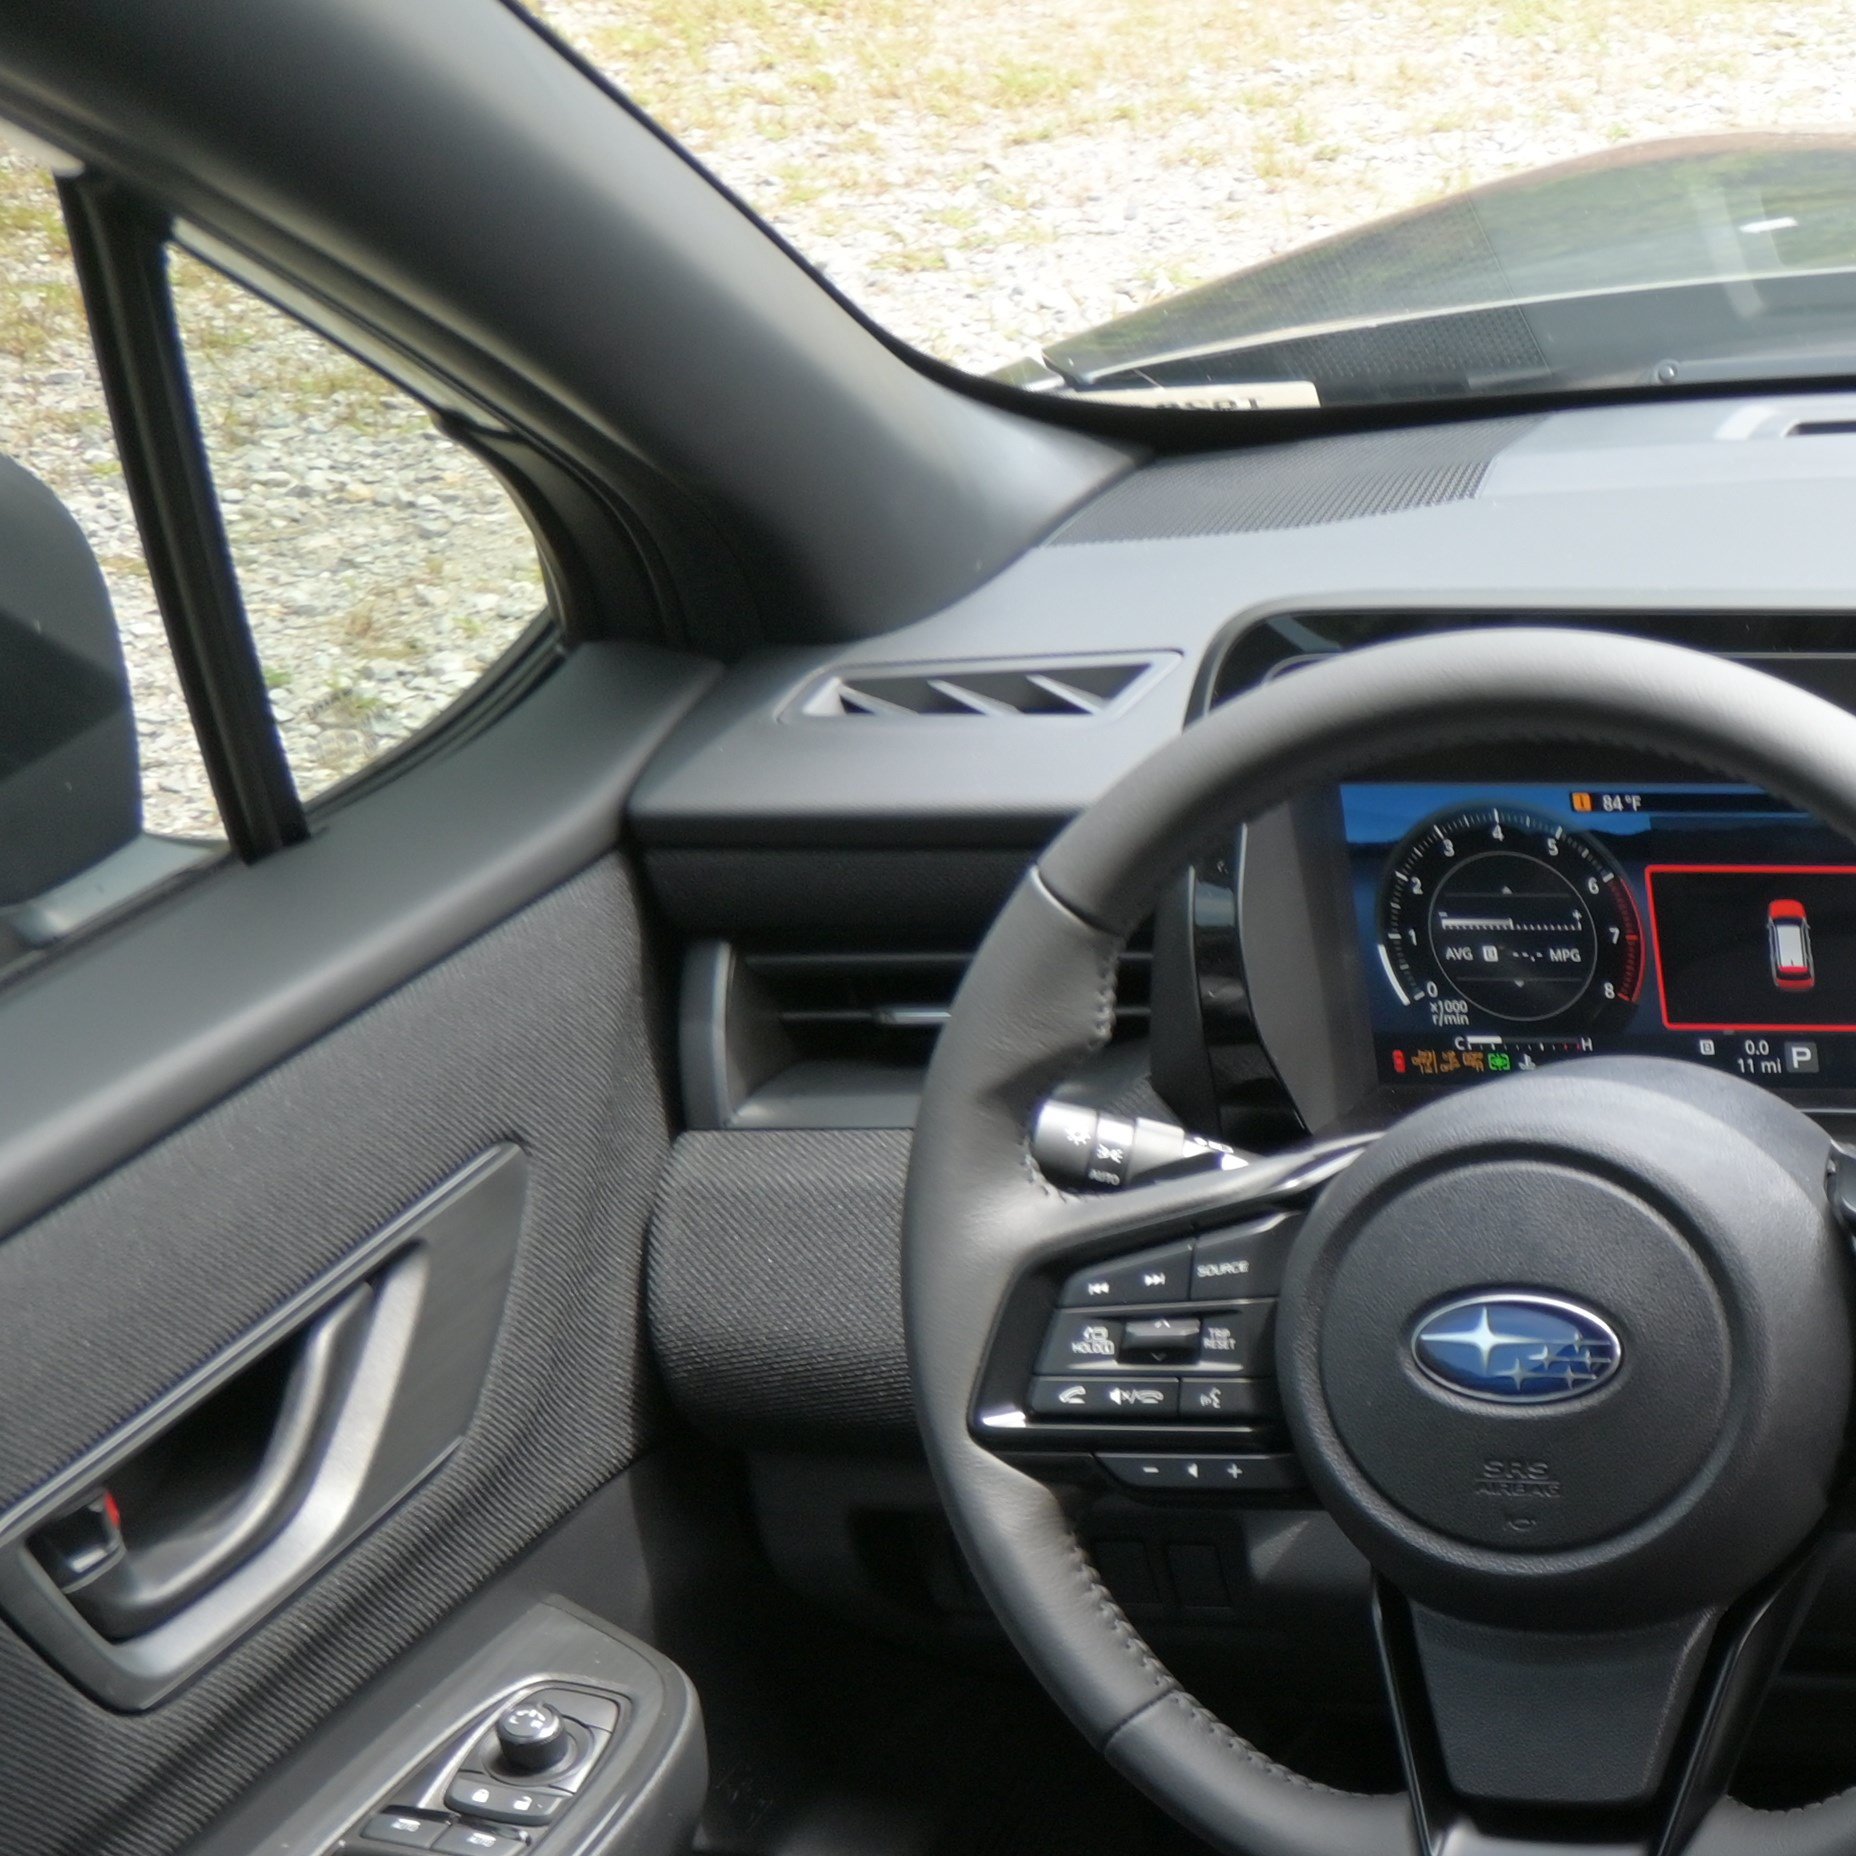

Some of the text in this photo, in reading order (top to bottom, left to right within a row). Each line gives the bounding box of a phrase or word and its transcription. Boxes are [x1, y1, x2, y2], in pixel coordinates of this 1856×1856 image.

[1492, 826, 1504, 842] 4
[1444, 840, 1455, 857] 3
[1547, 839, 1559, 857] 5
[1411, 878, 1424, 895] 2
[1588, 877, 1600, 895] 6
[1408, 929, 1418, 946] 1
[1609, 927, 1620, 946] 7
[1445, 947, 1582, 963] AVG MPG
[1426, 981, 1439, 998] 0
[1604, 982, 1616, 999] 8
[1430, 1001, 1469, 1015] x1000
[1433, 1013, 1470, 1027] r/min
[1455, 1037, 1466, 1051] C
[1582, 1037, 1593, 1051] H
[1745, 1040, 1770, 1056] 0.0
[1738, 1058, 1782, 1074] 11 mi
[1791, 1047, 1812, 1069] P
[1088, 1169, 1120, 1186] AUTO
[1197, 1260, 1250, 1278] SOURCE
[1208, 1327, 1231, 1338] TRIP
[1203, 1337, 1237, 1351] RESET
[1483, 1461, 1550, 1480] SRS
[1475, 1483, 1562, 1499] AIRBAG
